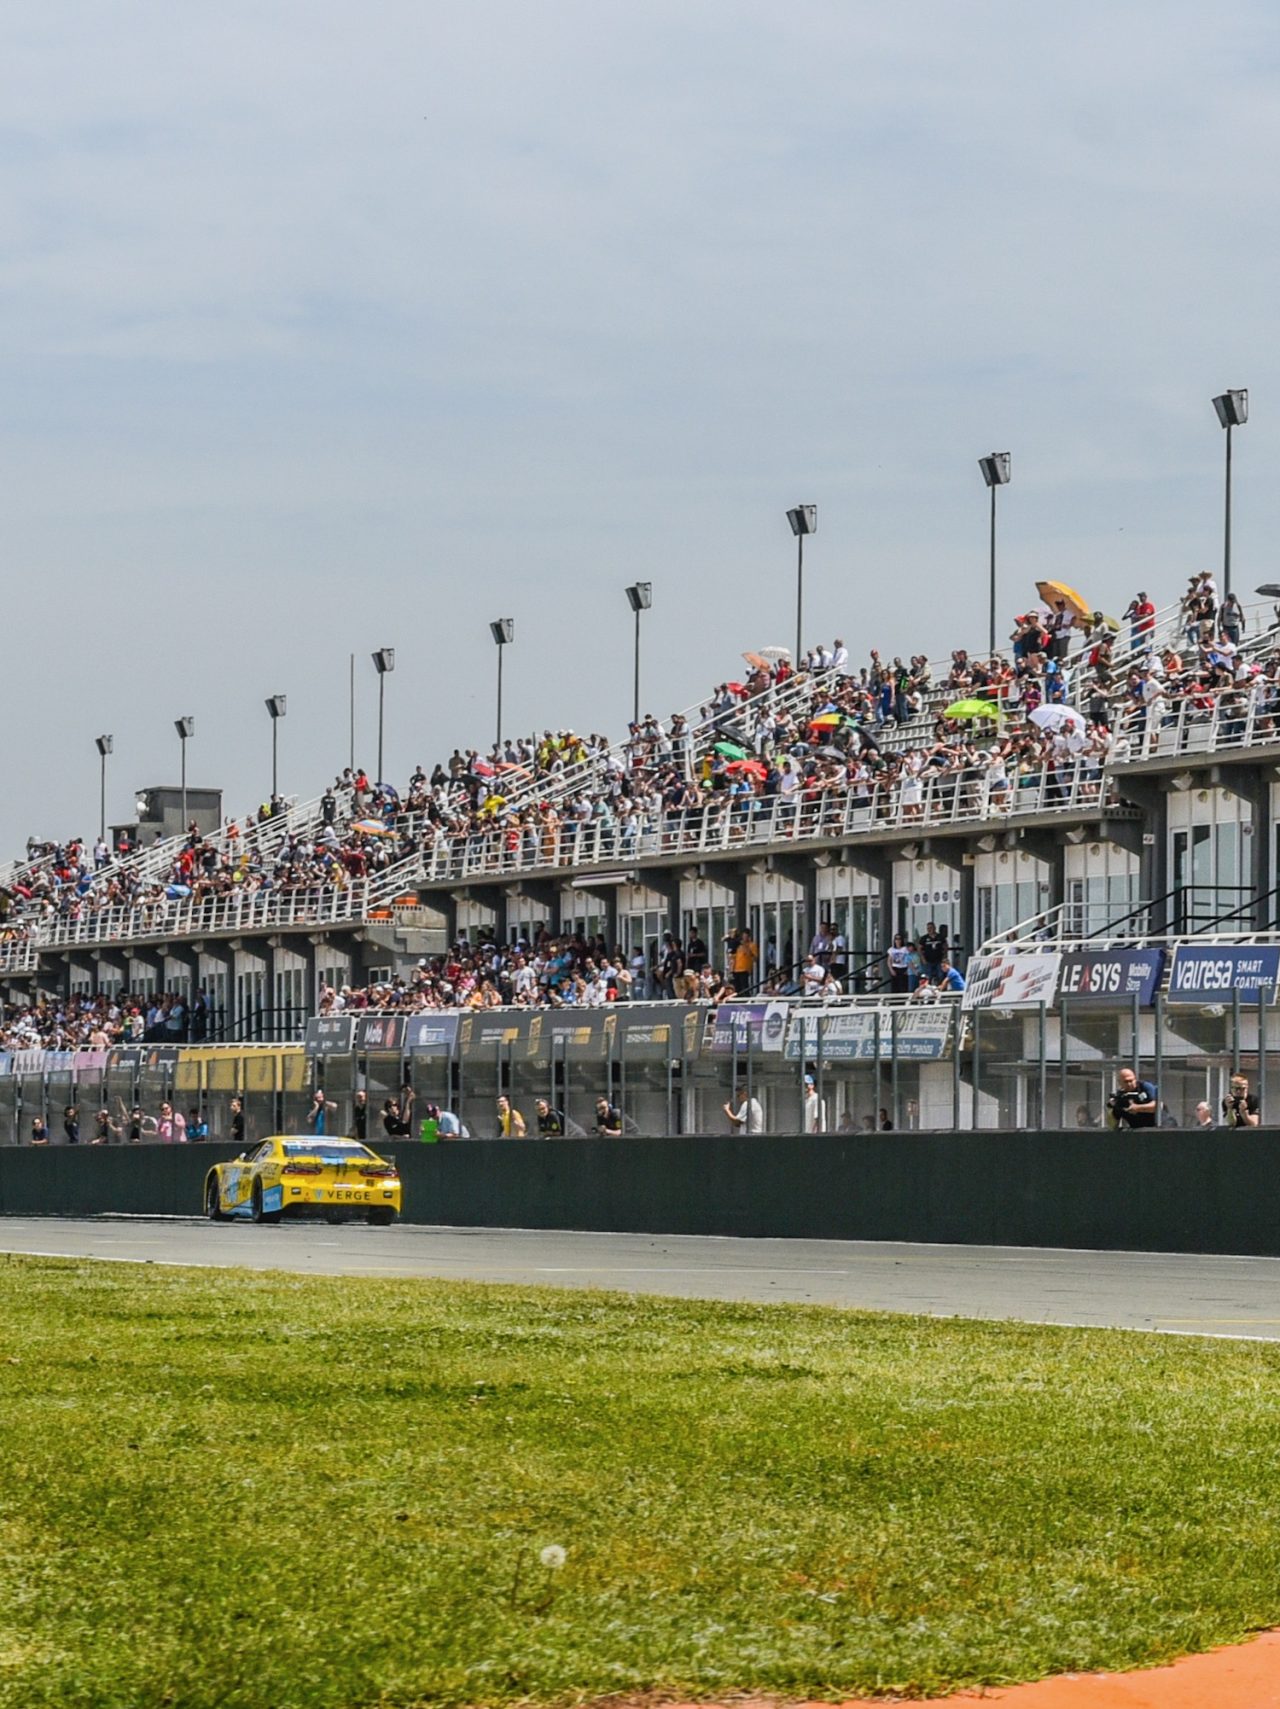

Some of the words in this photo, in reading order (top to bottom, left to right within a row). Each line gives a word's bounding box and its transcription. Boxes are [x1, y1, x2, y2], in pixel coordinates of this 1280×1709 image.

[1236, 959, 1264, 973] SMART
[1061, 962, 1121, 993] LEASYS
[327, 1190, 371, 1201] VERGE
